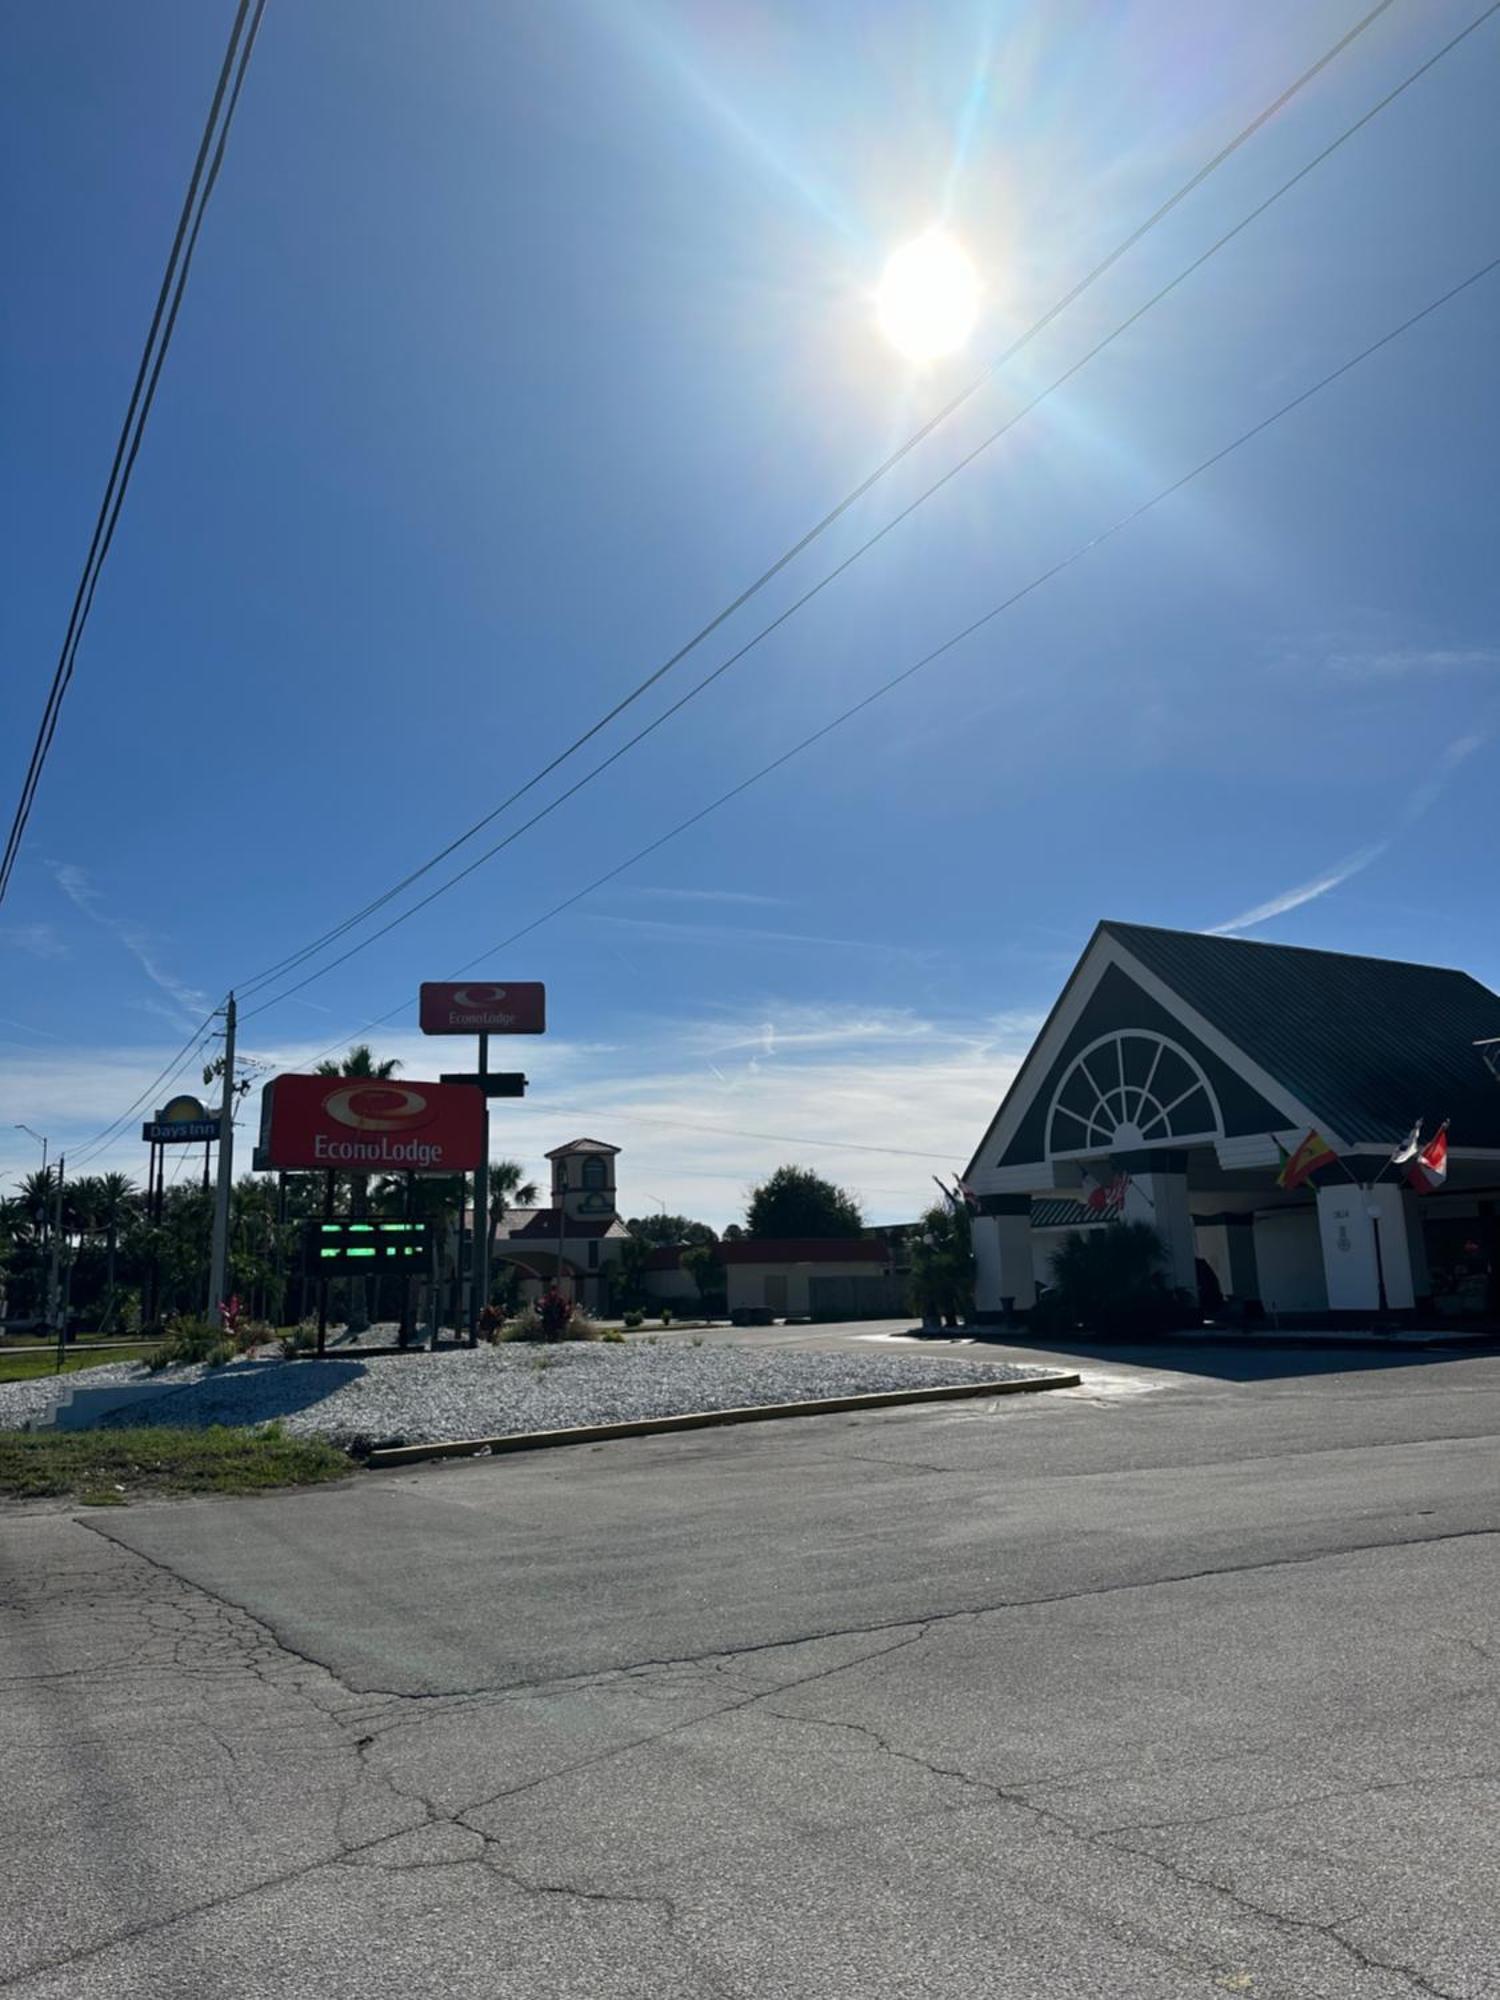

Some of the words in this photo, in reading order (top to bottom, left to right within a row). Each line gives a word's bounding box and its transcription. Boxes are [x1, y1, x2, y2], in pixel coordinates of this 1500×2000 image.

[151, 1125, 187, 1138] Days
[189, 1123, 215, 1136] Inn
[314, 1134, 442, 1167] EconoLodge
